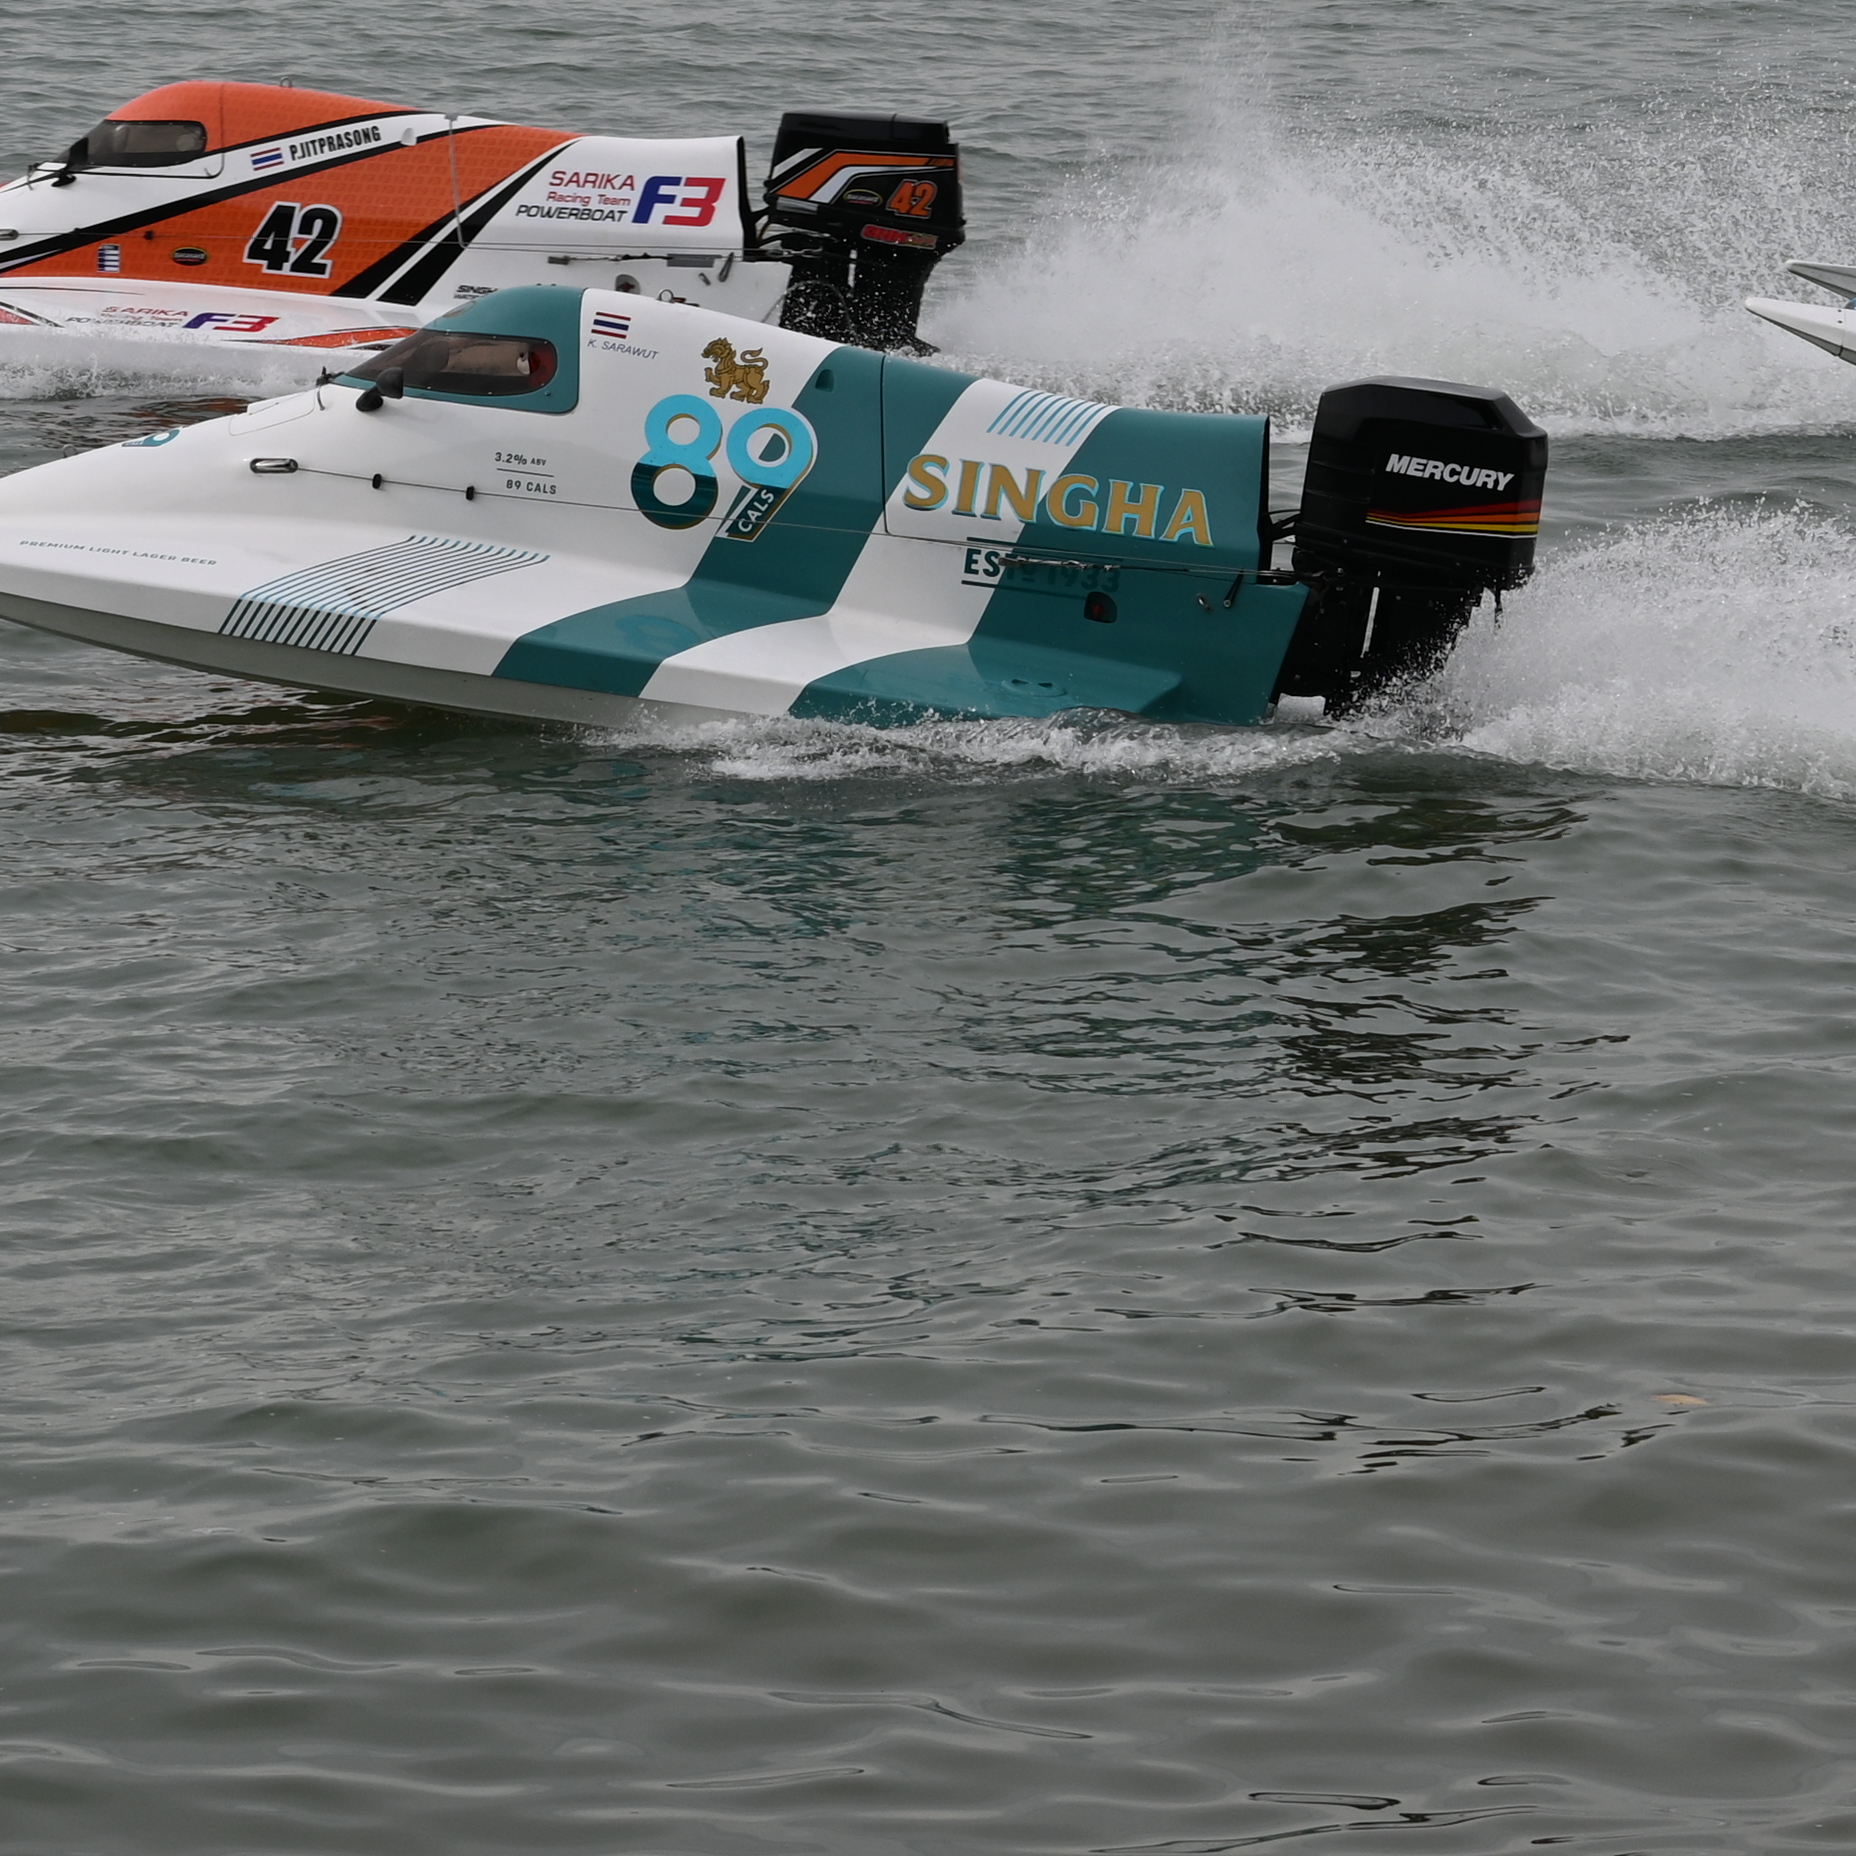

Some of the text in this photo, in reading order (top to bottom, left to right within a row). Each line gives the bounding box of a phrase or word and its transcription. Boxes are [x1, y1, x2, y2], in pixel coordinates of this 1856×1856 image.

[515, 204, 628, 223] POWERBOAT
[546, 191, 631, 206] Racing Team
[549, 170, 726, 227] SARIKA F3
[886, 179, 938, 219] 42
[243, 201, 342, 278] 42
[182, 311, 280, 333] F3
[601, 341, 659, 360] SARAWUT
[495, 451, 527, 465] 3.2%
[630, 394, 815, 541] 89
[1385, 453, 1515, 491] MERCURY
[506, 479, 557, 495] 89 CALS
[903, 454, 1214, 547] SINGHA
[738, 489, 775, 532] CALS
[19, 540, 217, 566] PREMIUM LIGHT LAGER BEER
